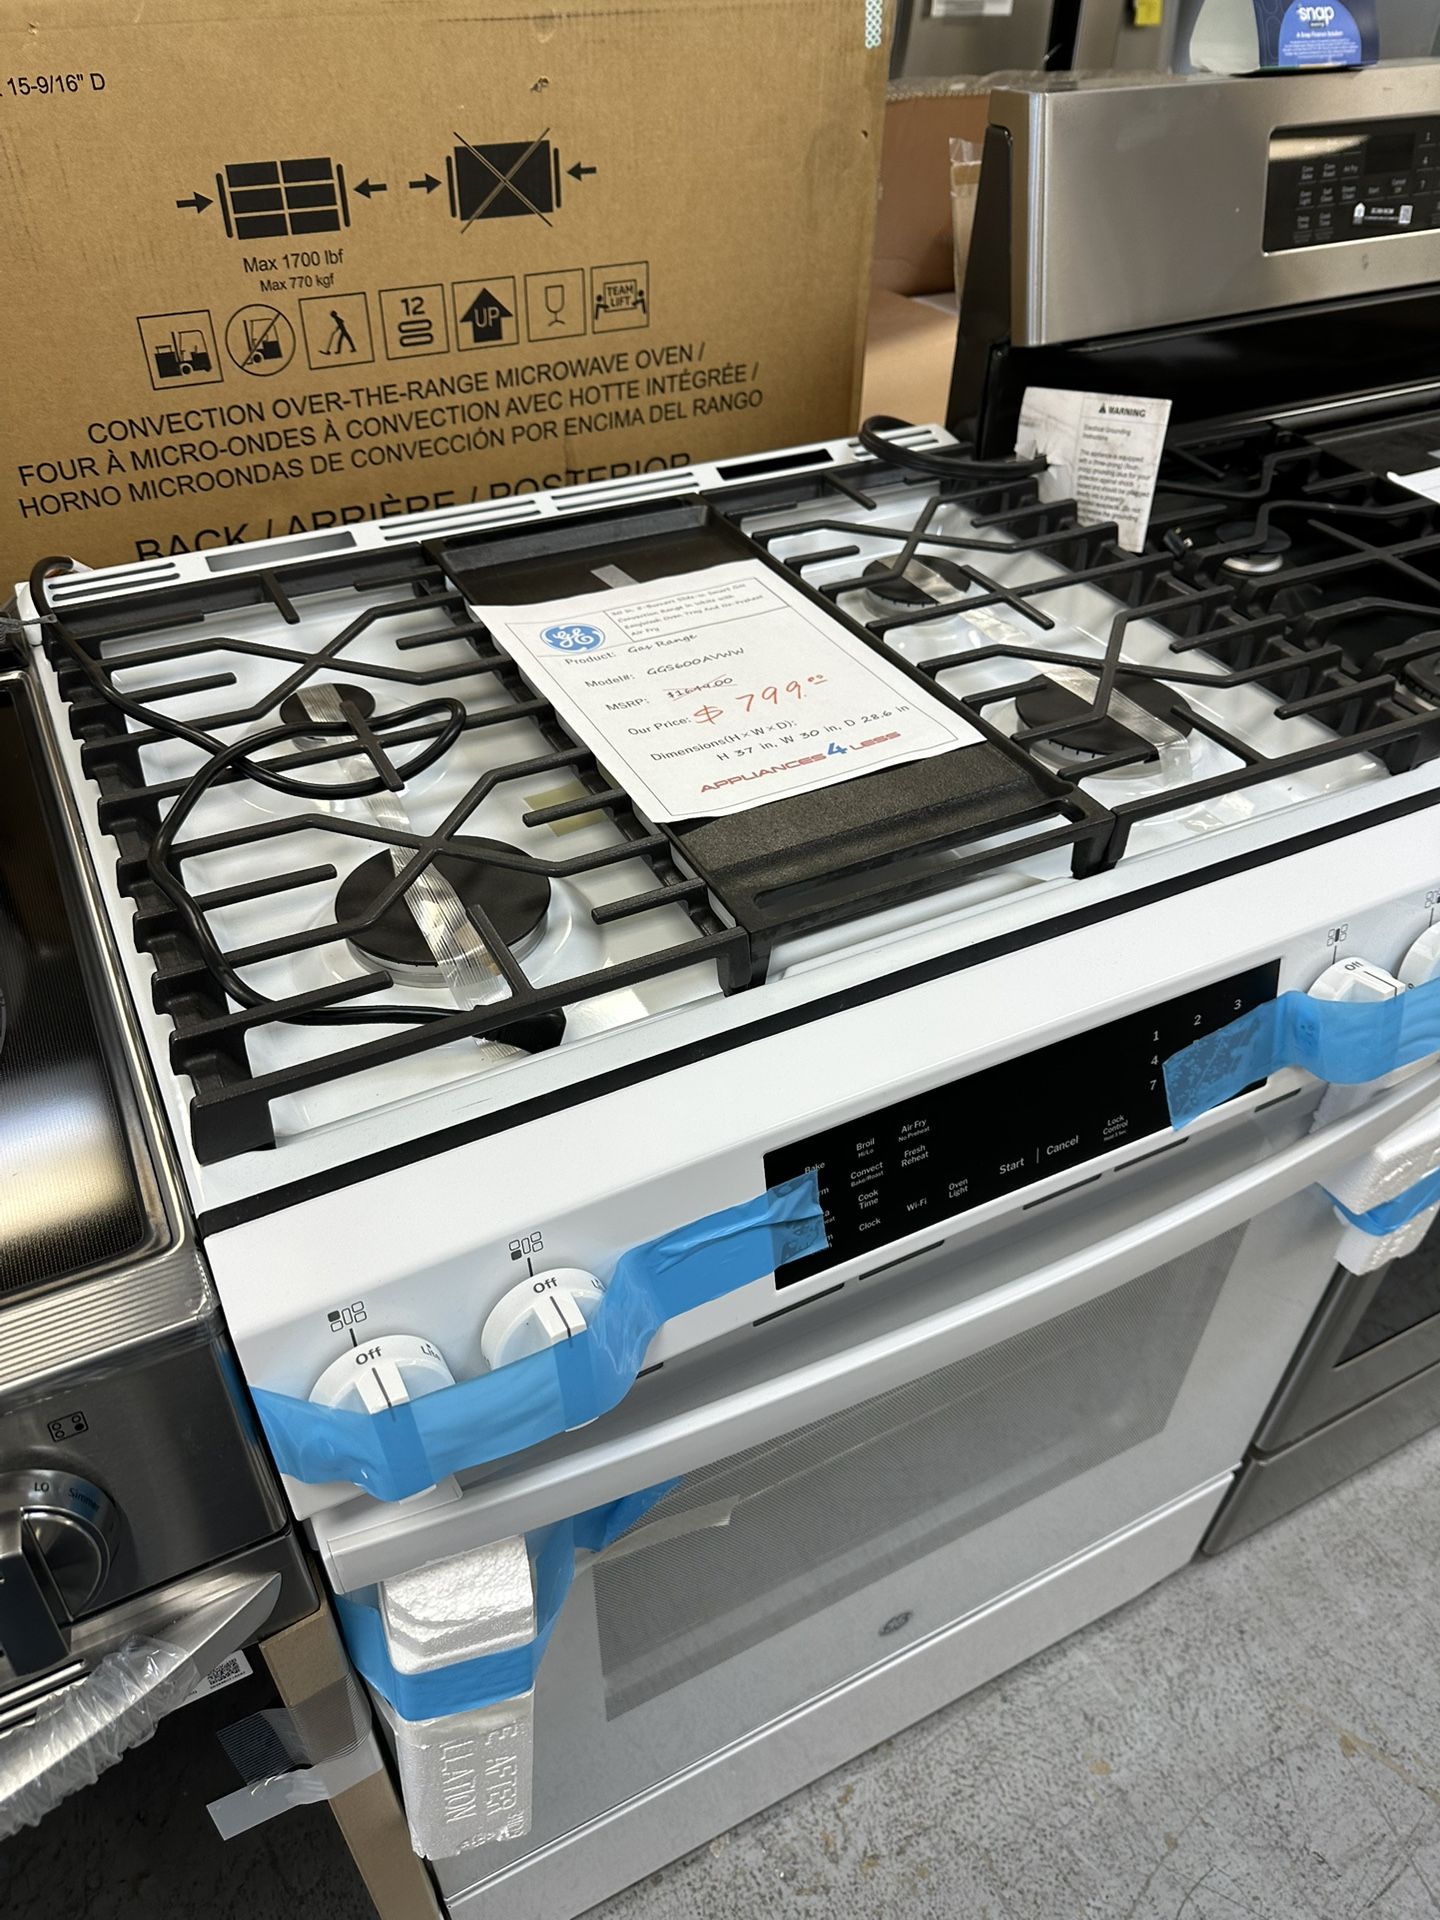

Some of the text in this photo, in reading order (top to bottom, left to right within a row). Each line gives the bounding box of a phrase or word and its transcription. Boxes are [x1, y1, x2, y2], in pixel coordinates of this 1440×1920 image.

[1298, 6, 1335, 26] snap
[7, 73, 105, 96] 15-9/16" D
[243, 249, 343, 273] Max 1700 lbf
[260, 273, 334, 292] Max 770 kgf
[607, 284, 634, 297] TEAM
[400, 295, 425, 317] 12
[610, 296, 632, 307] LIFT
[473, 306, 500, 328] UP
[88, 342, 705, 444] CONVECTION OVER-THE-RANGE MICROWAVE OVEN /
[1108, 406, 1146, 418] WARNING
[18, 362, 759, 487] FOUR À MICRO-ONDES À CONVECTION AVEC HOTTE INTÉGRÉE /
[18, 389, 763, 519] HORNO MICROONDAS DE CONVECCIÓN POR ENCIMA DEL RANGO
[135, 523, 249, 561] BACK
[565, 634, 697, 665] Product: Gas Range
[585, 647, 744, 688] Model#: GGS600AVWW
[605, 698, 650, 714] MSRP:
[628, 727, 652, 736] Our
[653, 717, 691, 732] Price:
[717, 752, 730, 761] H
[734, 747, 753, 757] 37
[780, 735, 795, 745] W
[799, 729, 820, 739] 30
[844, 719, 856, 728] D
[860, 710, 893, 723] 28.6
[897, 704, 910, 713] in
[701, 731, 901, 793] APPLIANCES 4 LESS
[1344, 961, 1364, 971] Off
[1152, 999, 1242, 1041] 1 2 3
[1150, 1055, 1159, 1065] 4
[1150, 1080, 1157, 1091] 7
[901, 1119, 927, 1134] Air Fry
[1102, 1119, 1129, 1135] Control
[1107, 1114, 1125, 1127] Lock
[856, 1138, 875, 1151] Broil
[858, 1148, 874, 1158] Hi/Lo
[904, 1144, 926, 1158] Fresh
[901, 1151, 929, 1168] Reheat
[999, 1134, 1079, 1175] Start Cancel
[850, 1161, 883, 1180] Convect
[850, 1170, 884, 1188] Bake/Roast
[948, 1178, 968, 1191] Oven
[948, 1185, 969, 1198] Light
[858, 1189, 879, 1202] Cook
[859, 1198, 879, 1210] Time
[906, 1198, 927, 1212] Wi-Fi
[858, 1217, 881, 1232] Clock
[533, 1276, 559, 1294] Off
[355, 1346, 382, 1366] Off
[34, 1481, 50, 1493] LO
[440, 1740, 478, 1824] LLATION
[485, 1755, 518, 1817] AFTER
